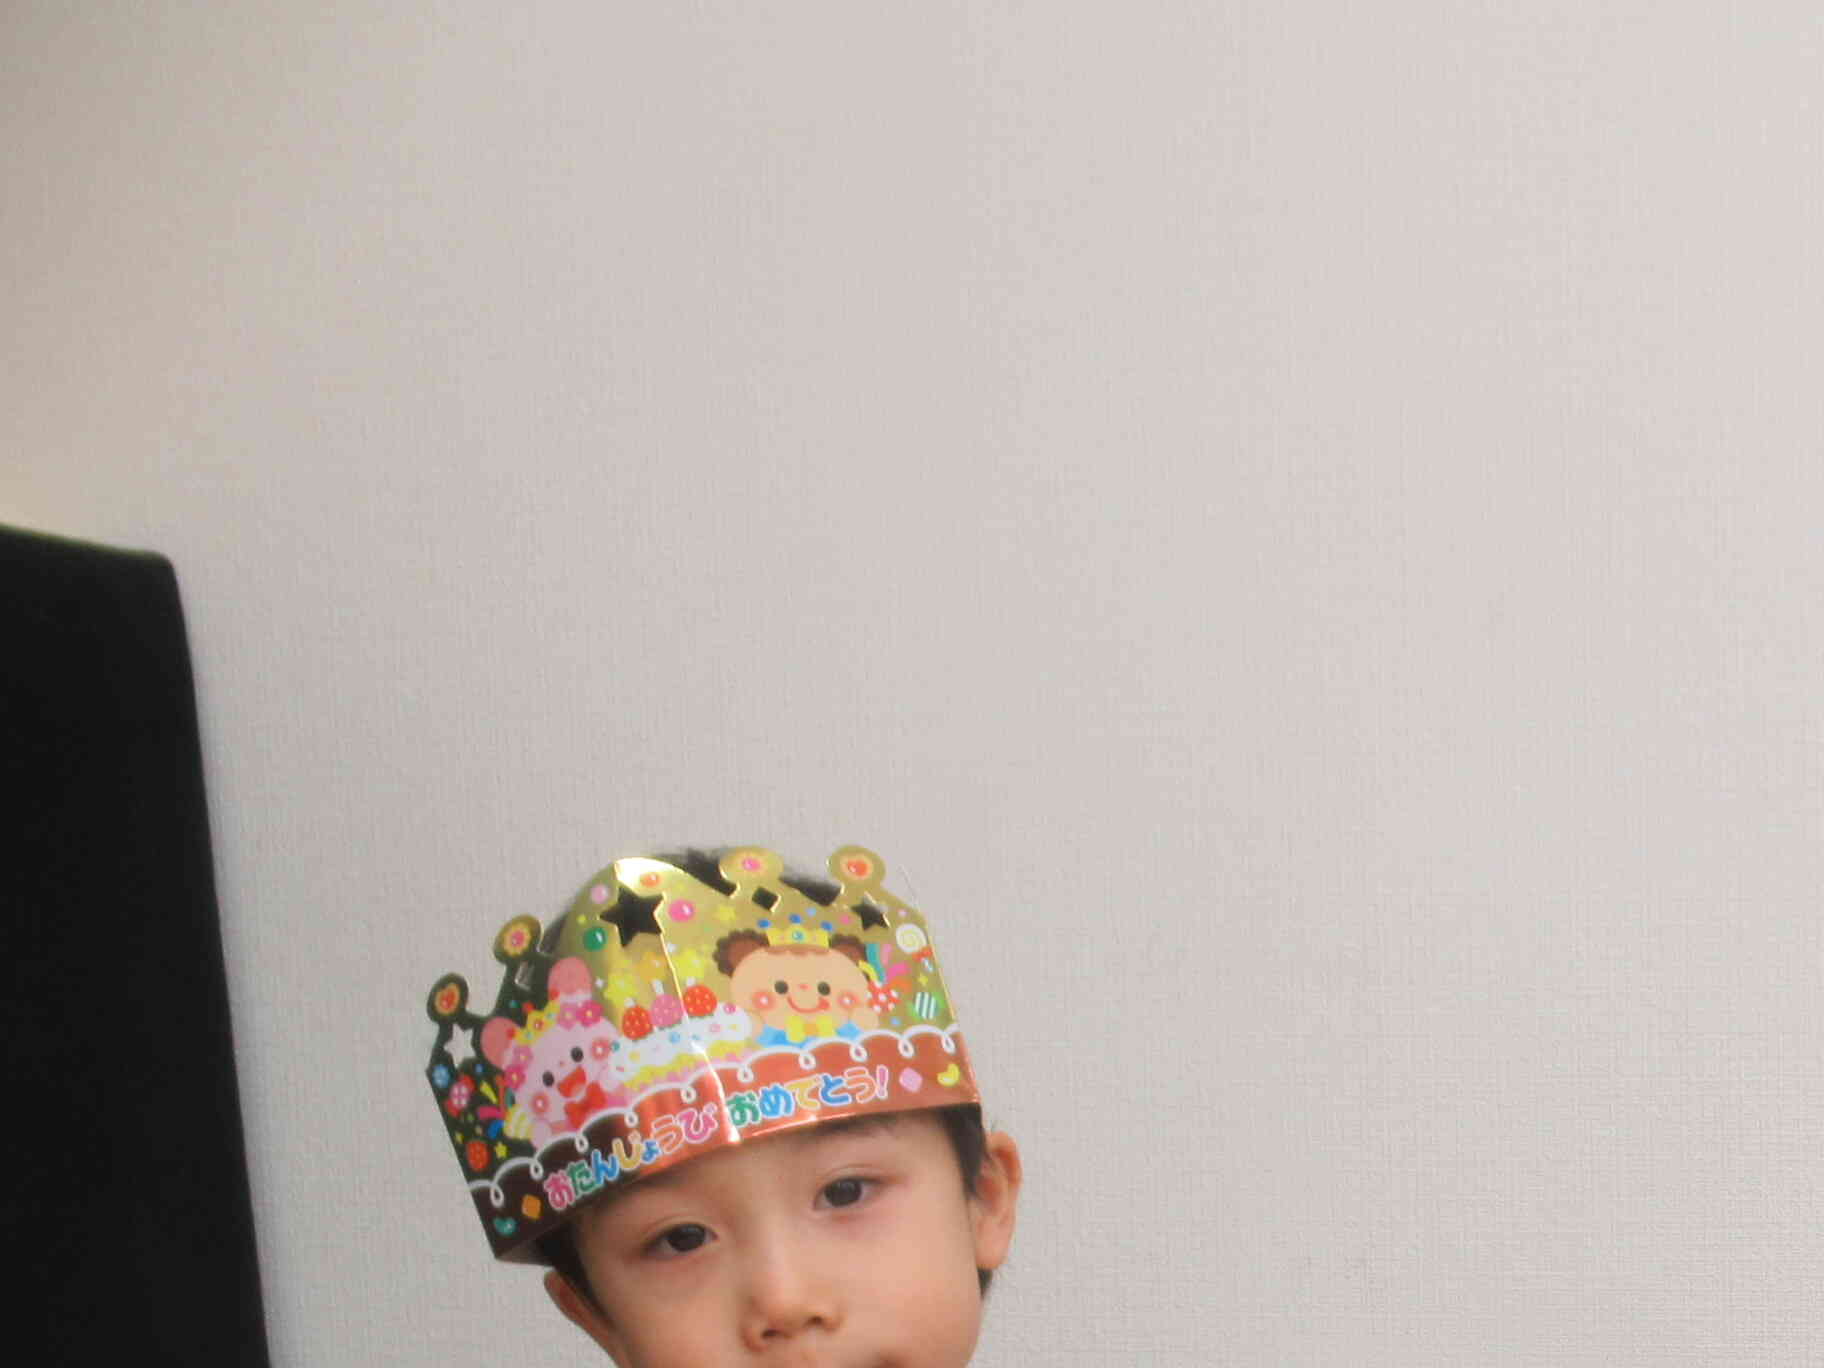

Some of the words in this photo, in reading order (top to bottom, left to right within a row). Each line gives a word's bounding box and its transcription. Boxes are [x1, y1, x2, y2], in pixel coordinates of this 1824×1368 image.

[544, 1103, 718, 1211] おたんじょうび
[726, 1064, 889, 1128] おめでとう!
